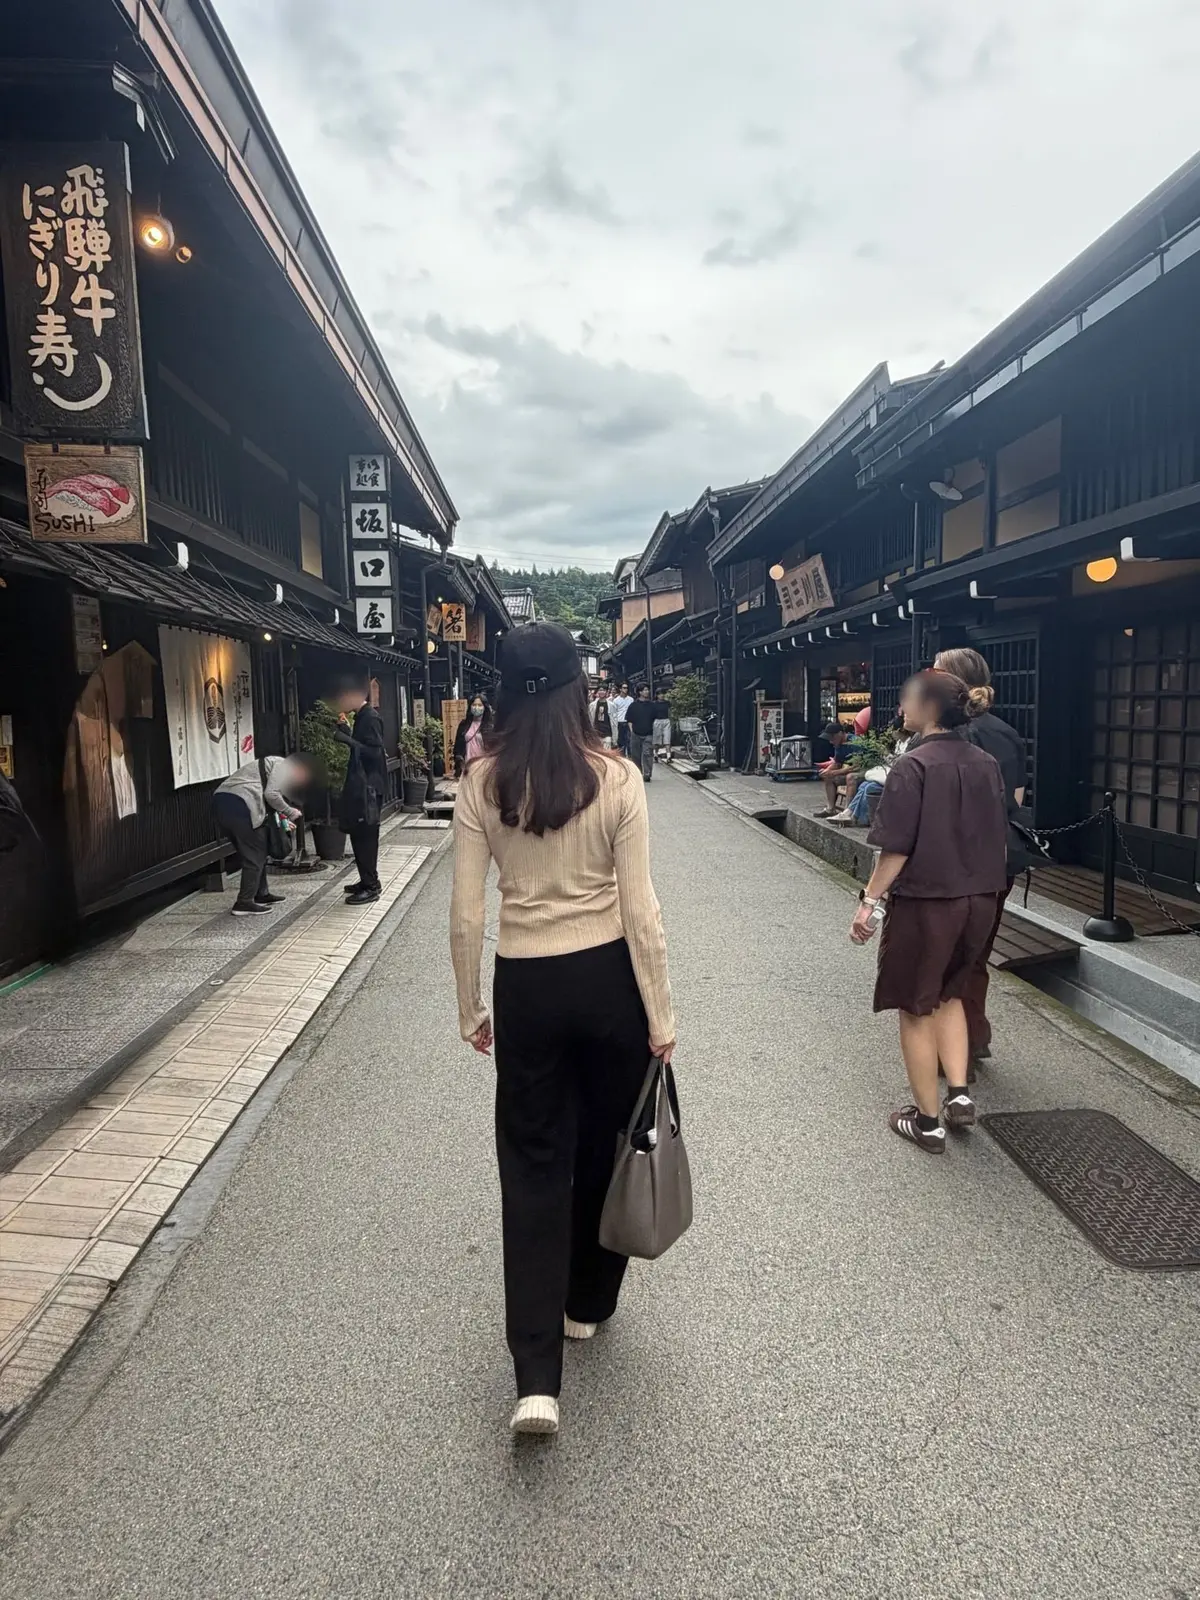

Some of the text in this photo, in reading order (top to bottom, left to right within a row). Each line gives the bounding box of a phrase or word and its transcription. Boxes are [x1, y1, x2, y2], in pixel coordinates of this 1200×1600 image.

[60, 163, 116, 337] 飛騨牛
[34, 512, 96, 533] SUSHI
[444, 608, 464, 634] 箸
